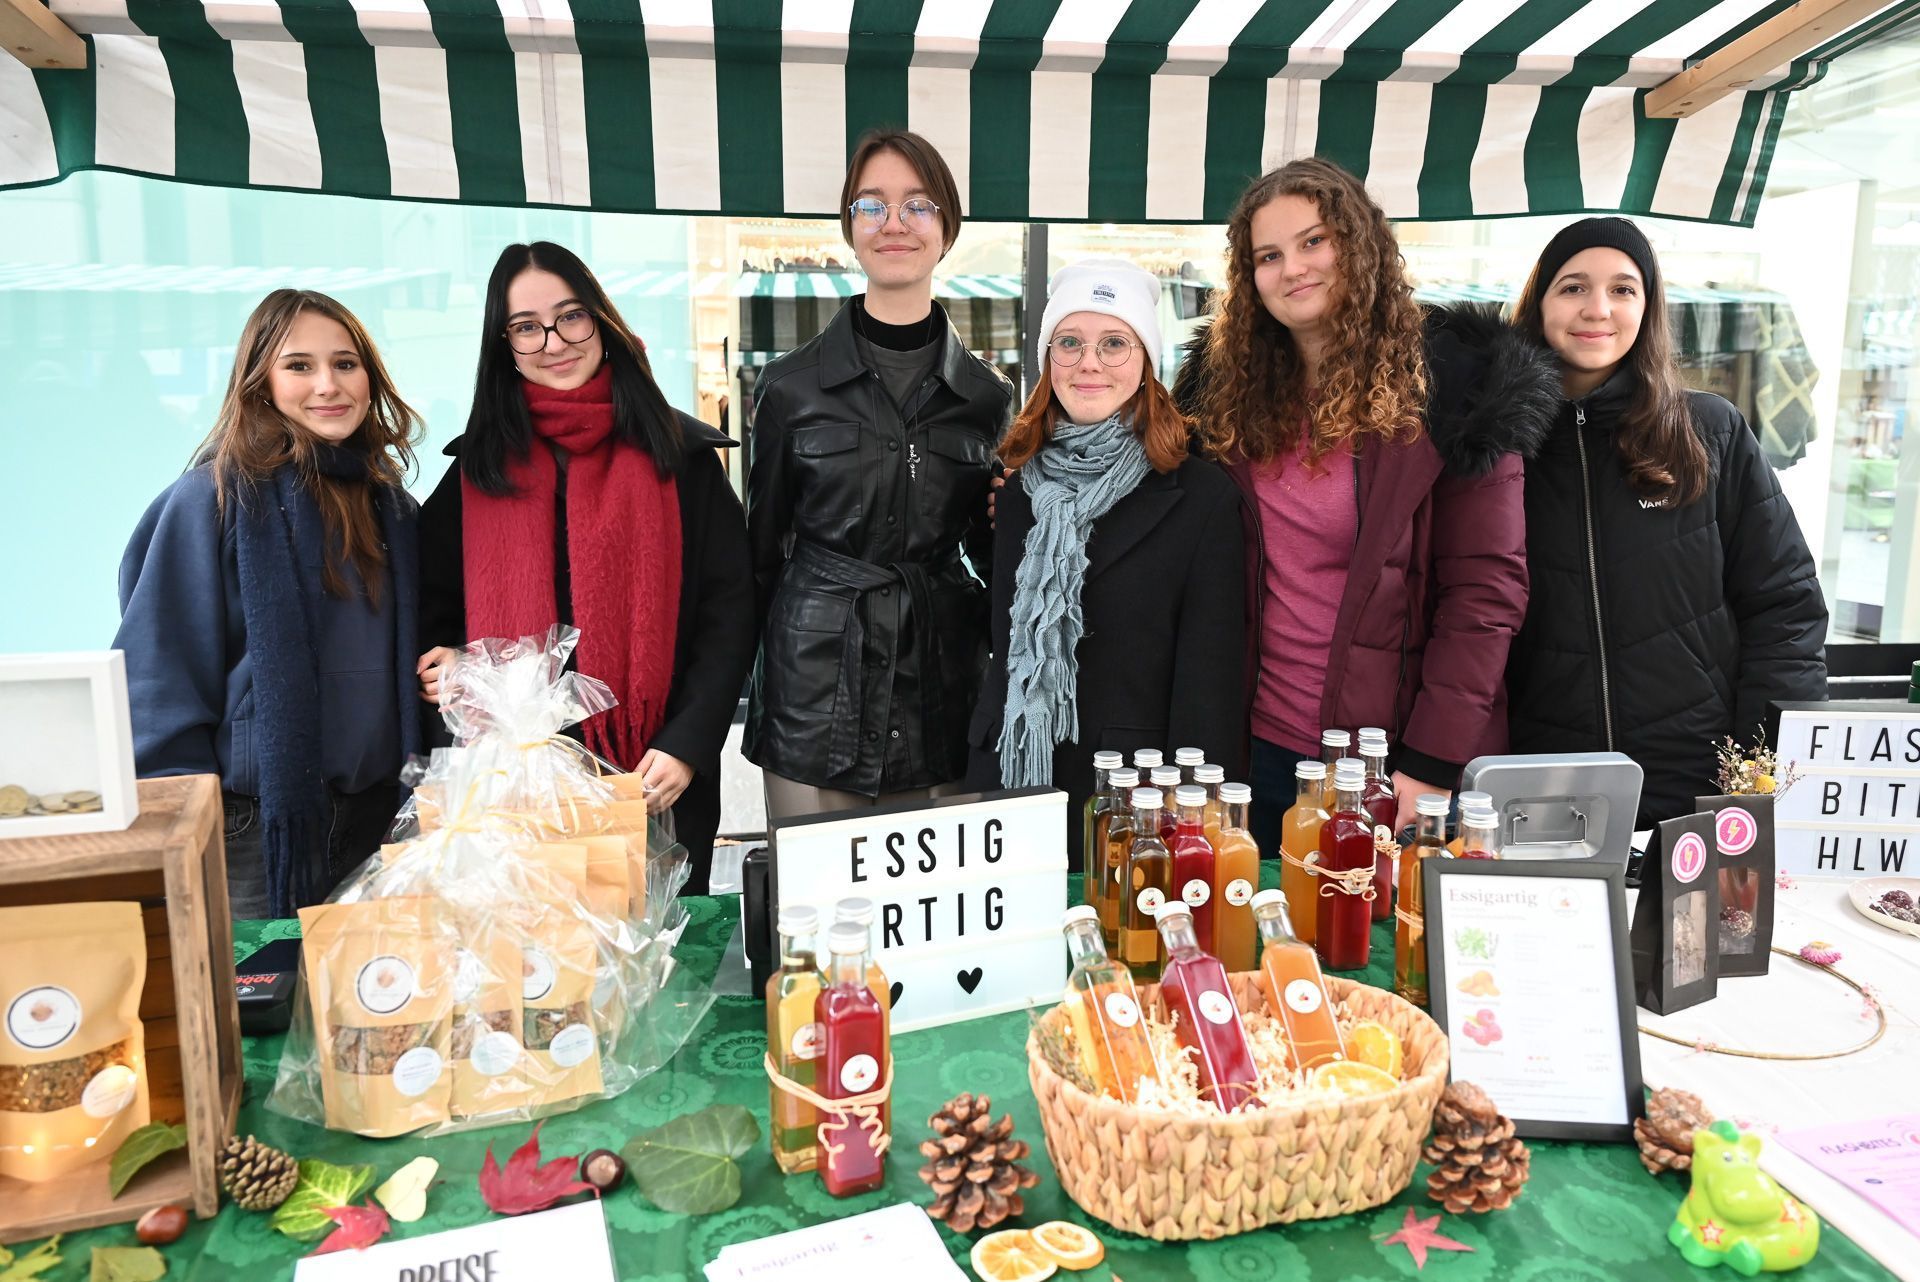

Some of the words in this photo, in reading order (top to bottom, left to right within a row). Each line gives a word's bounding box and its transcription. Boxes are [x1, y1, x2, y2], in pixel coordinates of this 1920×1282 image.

[1638, 497, 1669, 509] VANS
[1809, 726, 1920, 763] FLAS
[1821, 781, 1920, 818] BIT
[851, 818, 1003, 883] ESSIG
[1817, 836, 1908, 873] HLW
[1448, 887, 1538, 907] Essigartig
[882, 887, 1004, 949] RTIG
